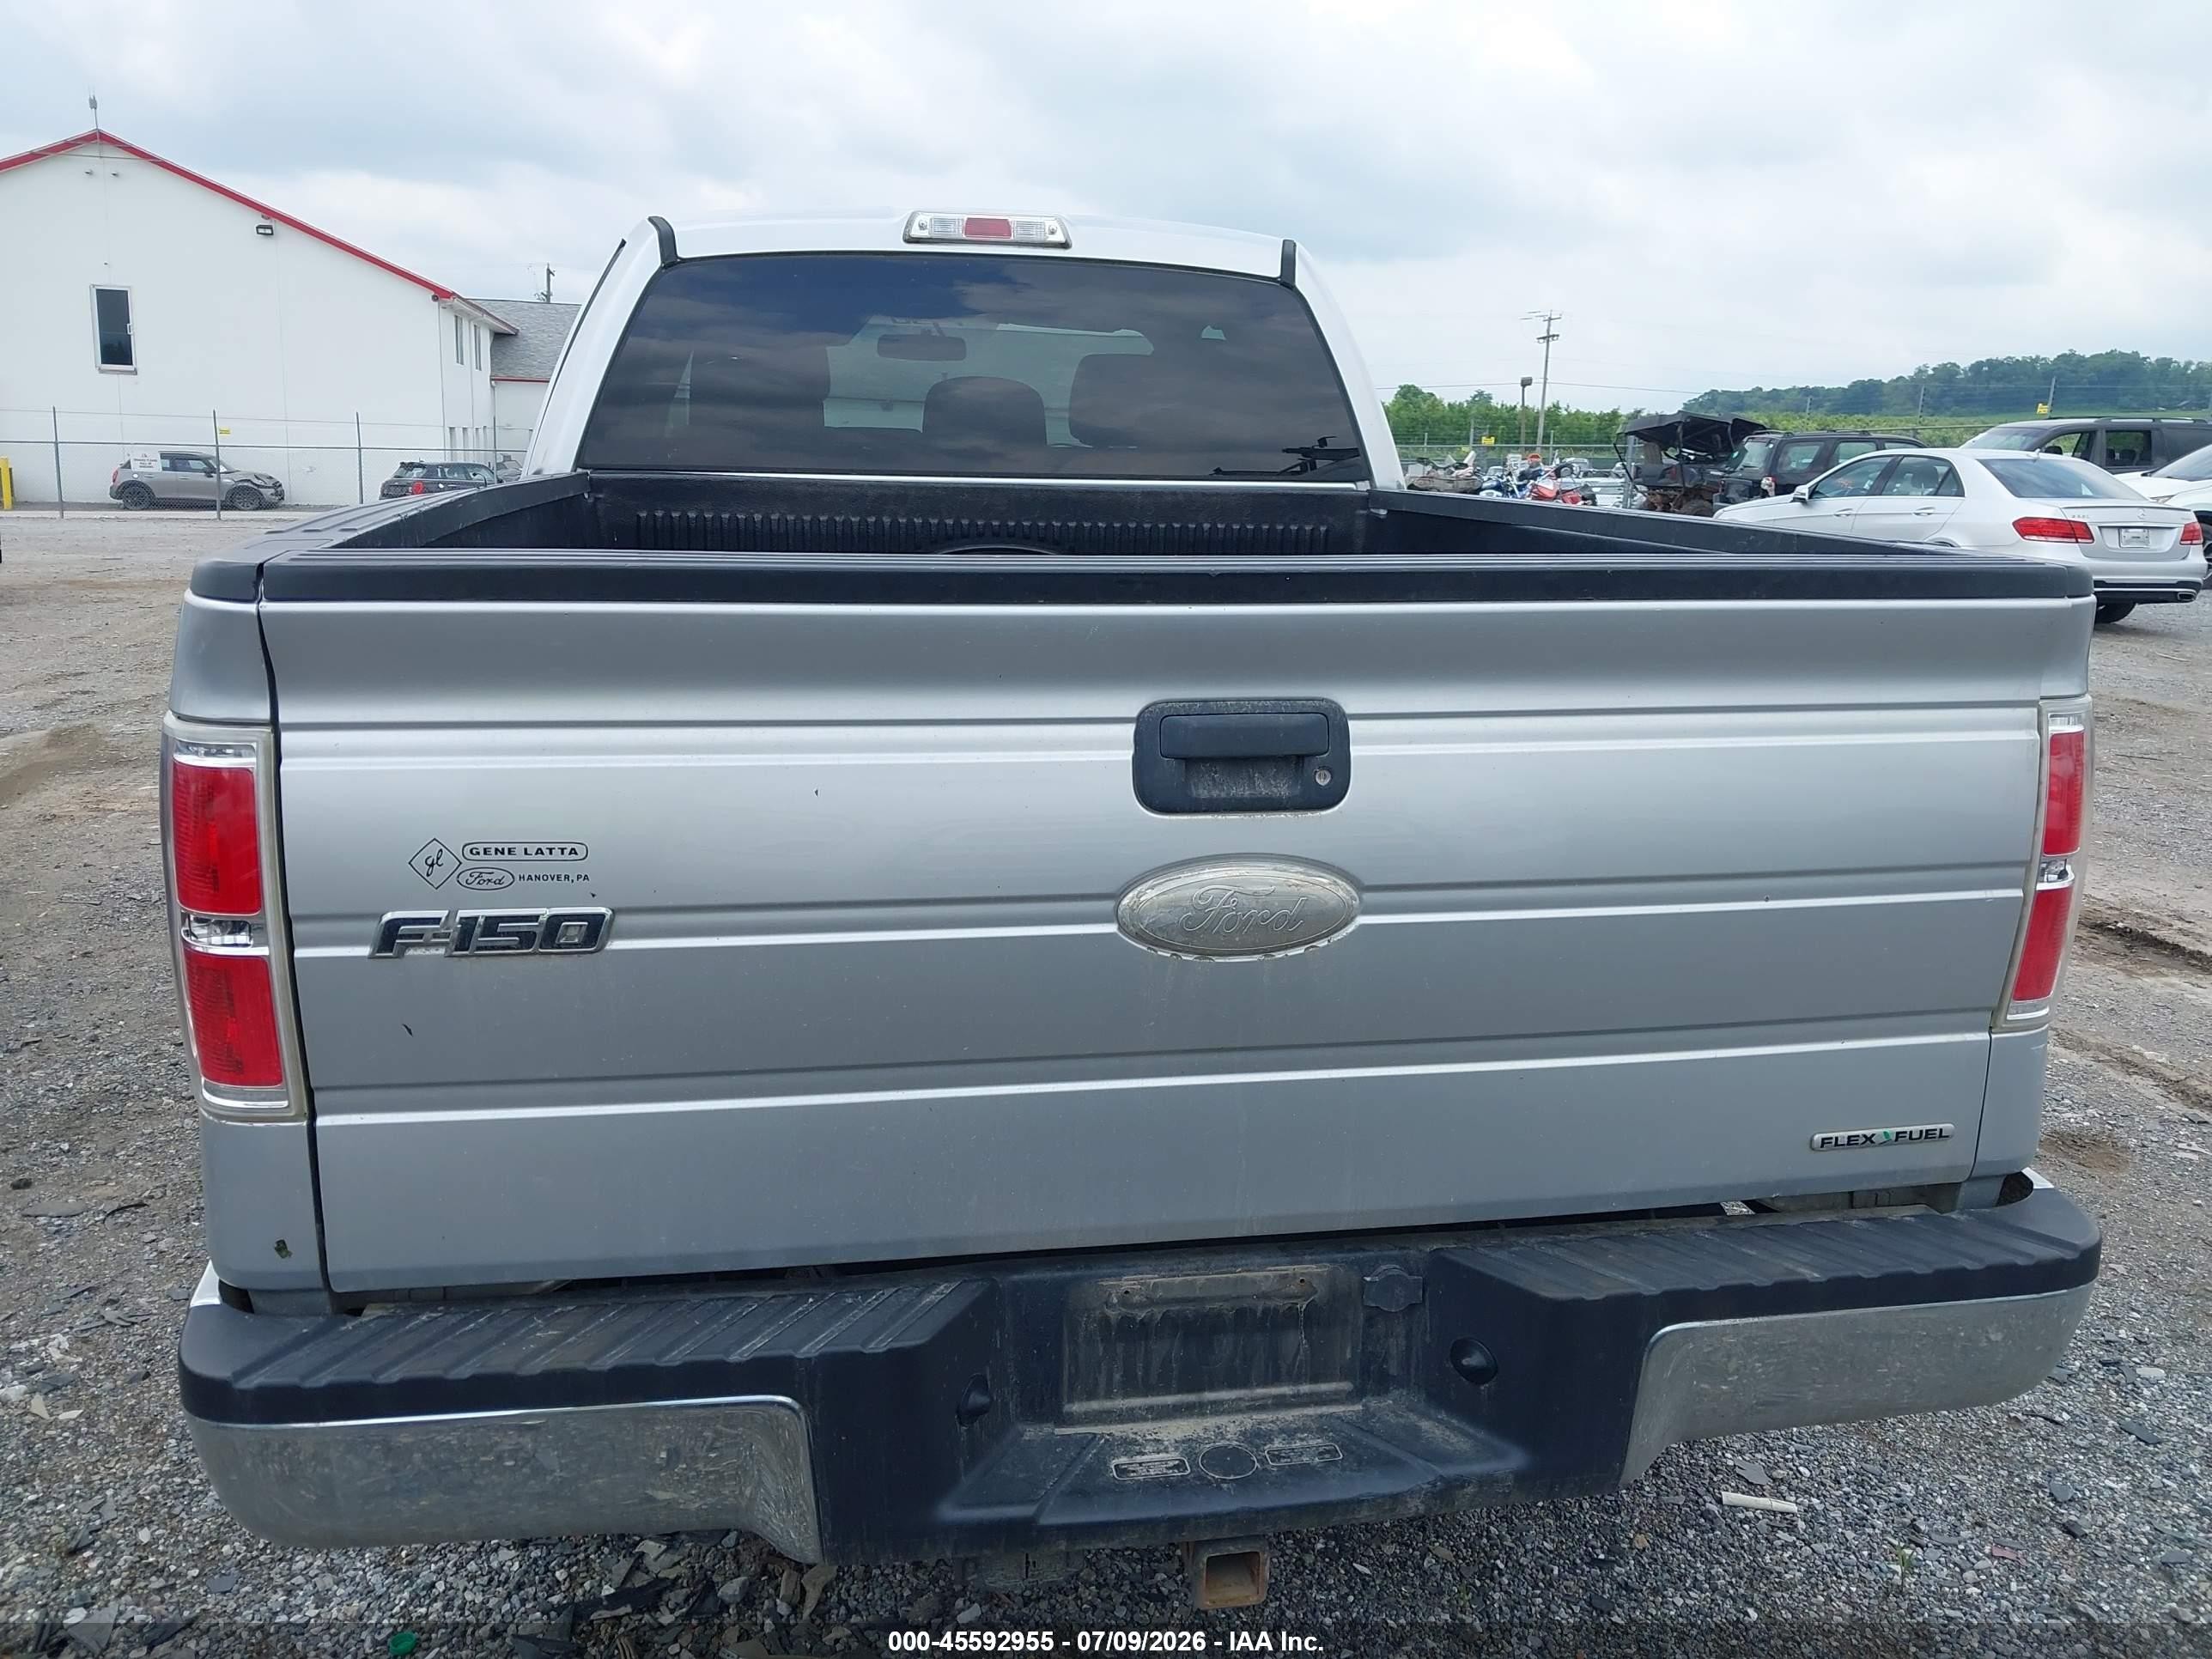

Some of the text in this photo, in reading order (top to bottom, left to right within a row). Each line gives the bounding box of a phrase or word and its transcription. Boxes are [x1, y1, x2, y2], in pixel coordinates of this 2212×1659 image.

[469, 846, 579, 856] GENE LATTA
[465, 870, 506, 886] Ford
[518, 873, 590, 884] HANOVER, PA
[1178, 884, 1309, 935] Ford
[368, 906, 615, 959] F-150
[1820, 1127, 1950, 1149] FLEX FUEL
